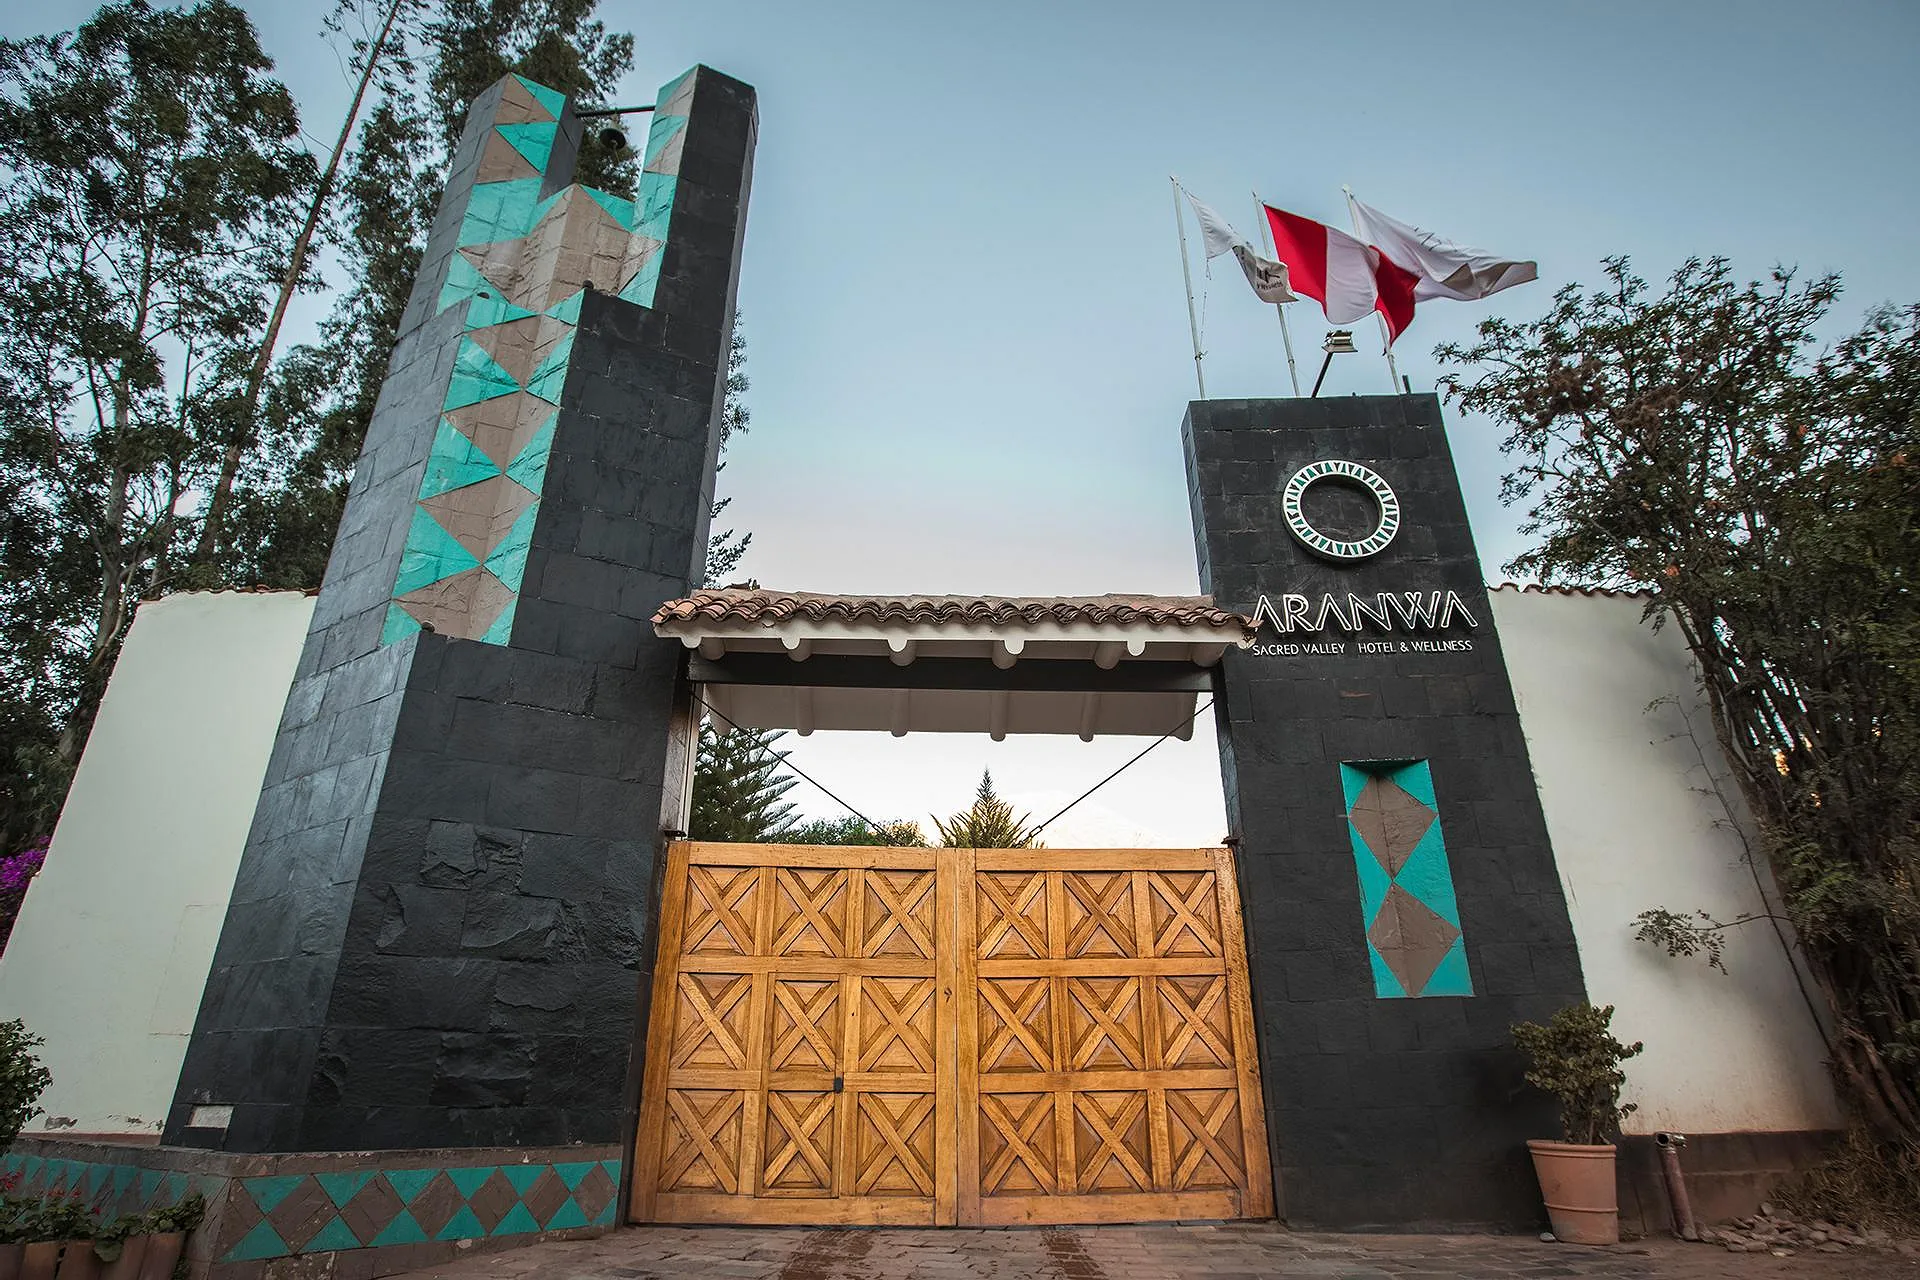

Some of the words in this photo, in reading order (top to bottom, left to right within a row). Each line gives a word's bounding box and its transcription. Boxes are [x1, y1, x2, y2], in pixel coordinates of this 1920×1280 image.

[1253, 590, 1479, 633] ARANWA
[1252, 644, 1299, 656] SACRED
[1302, 643, 1345, 655] VALLEY
[1358, 642, 1397, 653] HOTEL
[1400, 641, 1409, 653] &
[1411, 640, 1473, 652] WELLNESS
